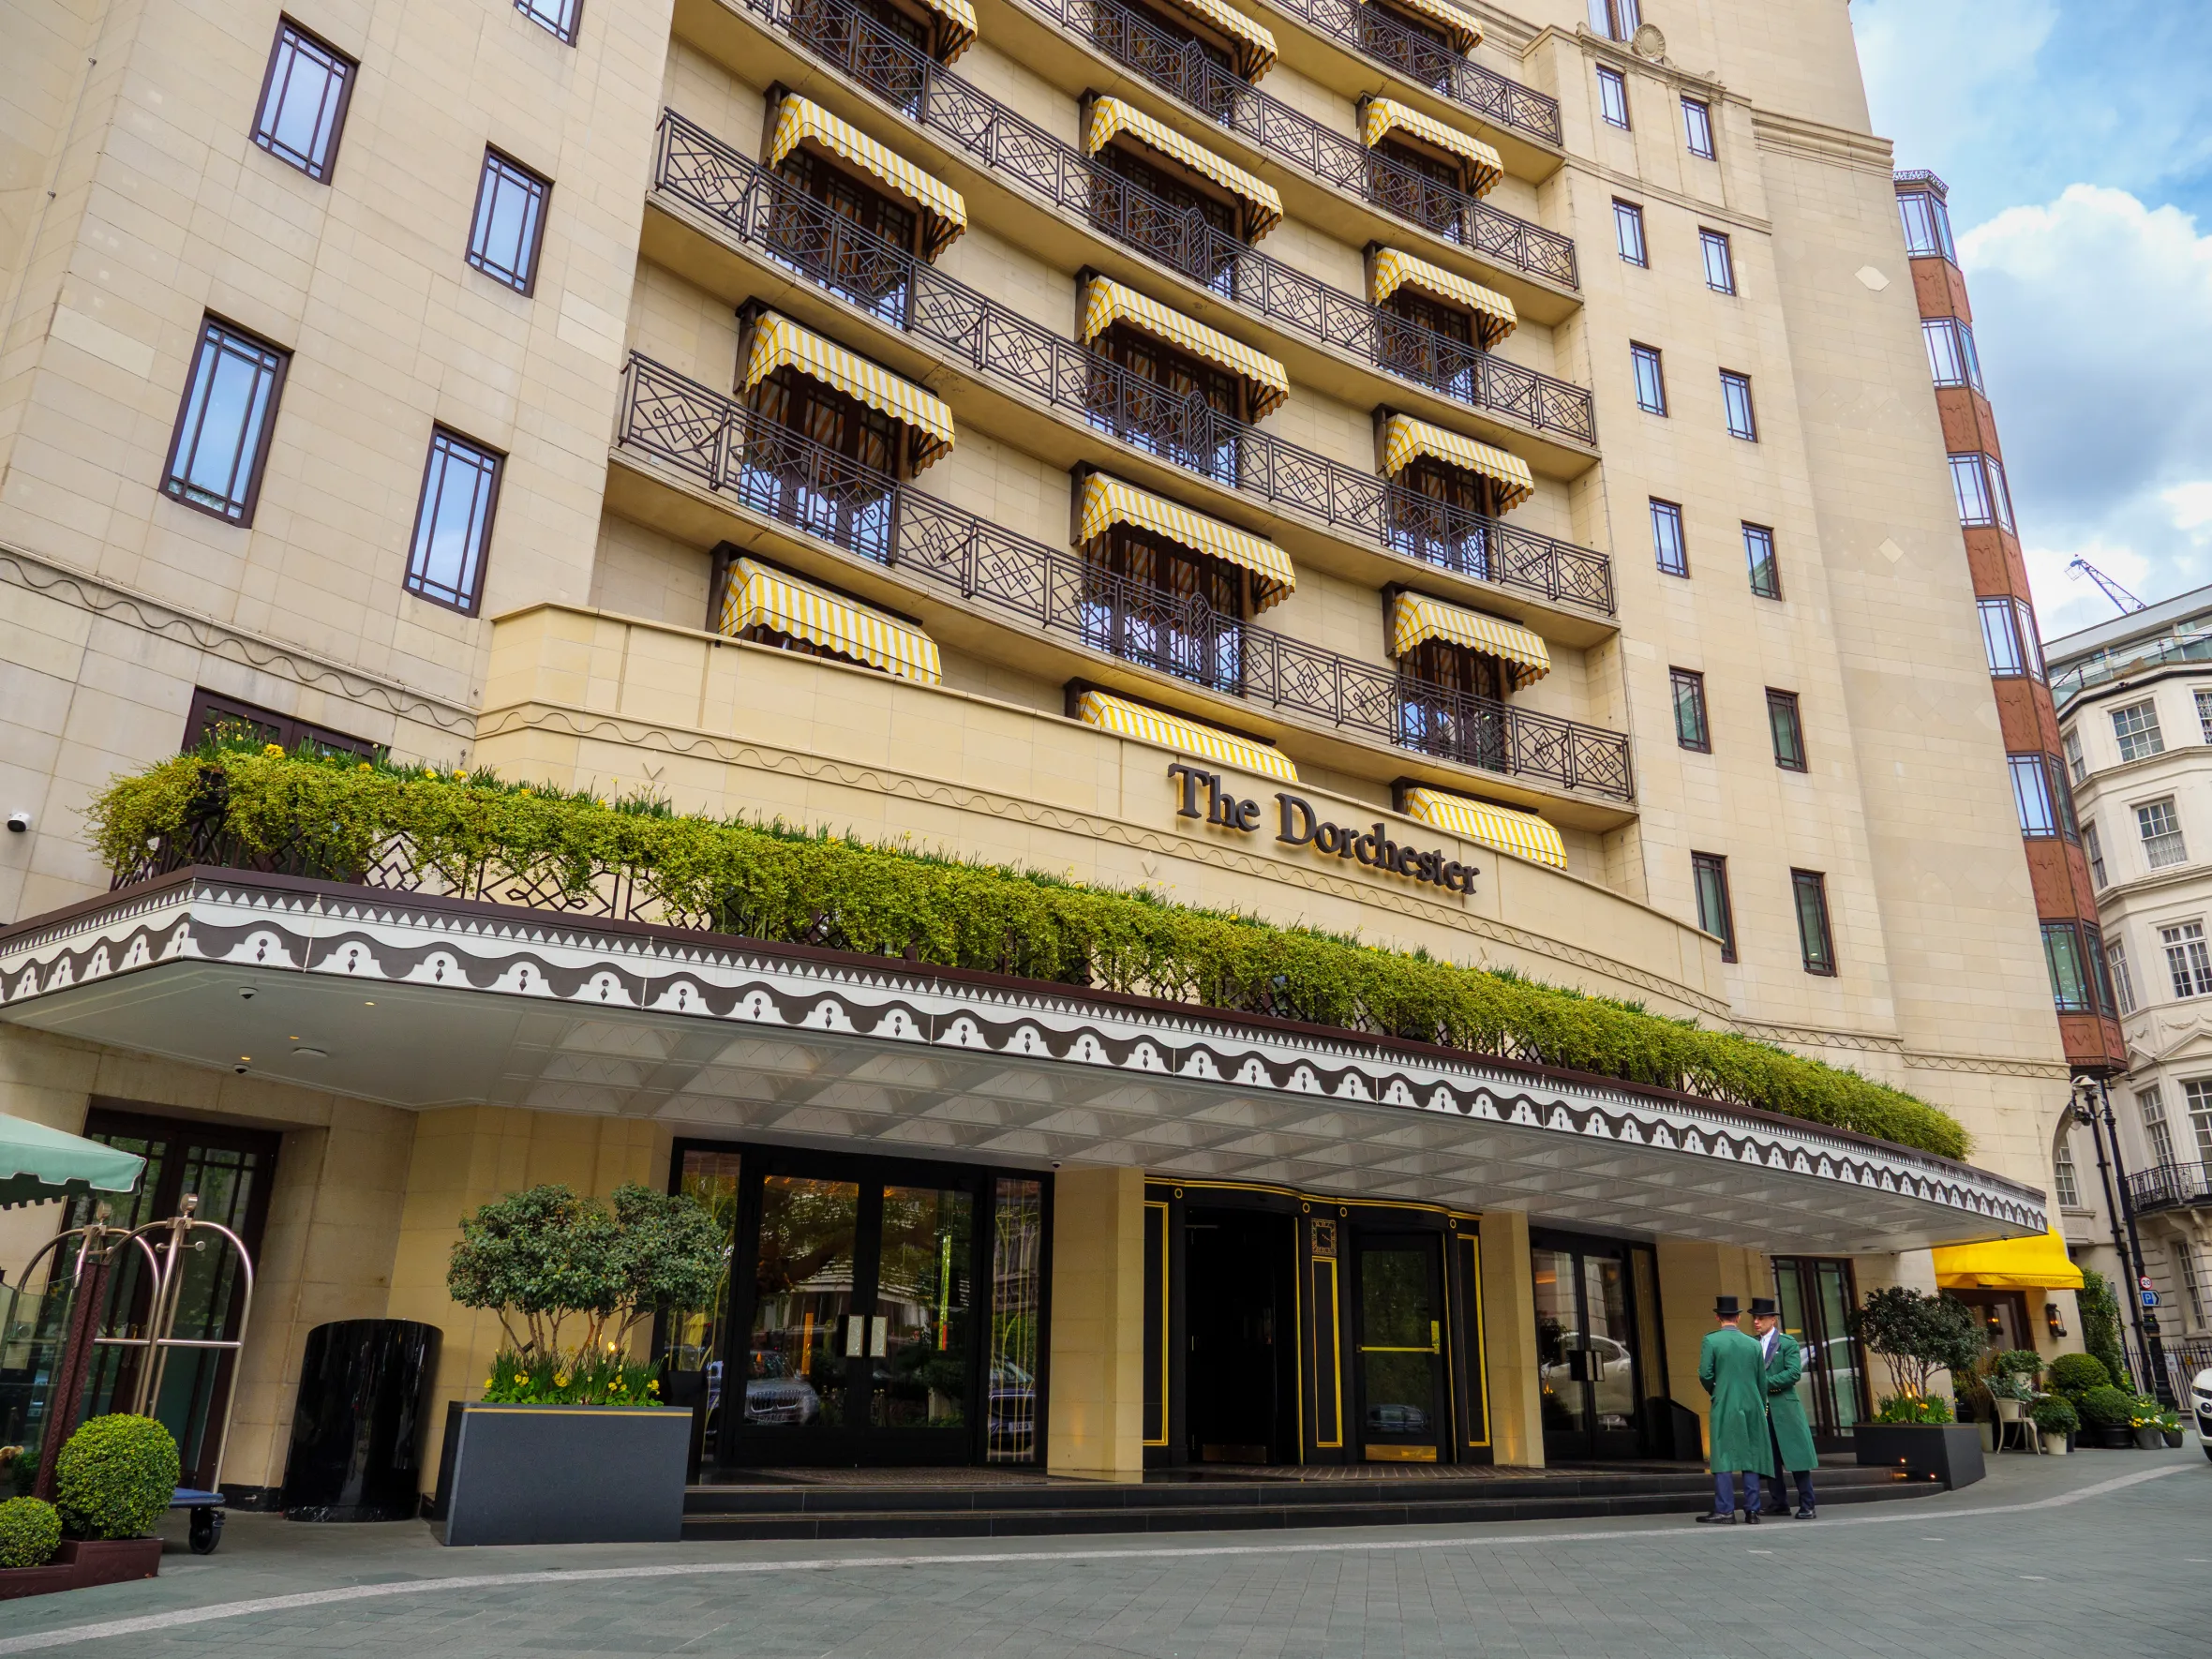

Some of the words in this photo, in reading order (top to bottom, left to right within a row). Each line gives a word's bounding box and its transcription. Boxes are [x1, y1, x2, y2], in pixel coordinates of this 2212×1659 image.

[1168, 763, 1260, 832] The
[1275, 793, 1480, 895] Dorchester
[2145, 1293, 2152, 1304] P
